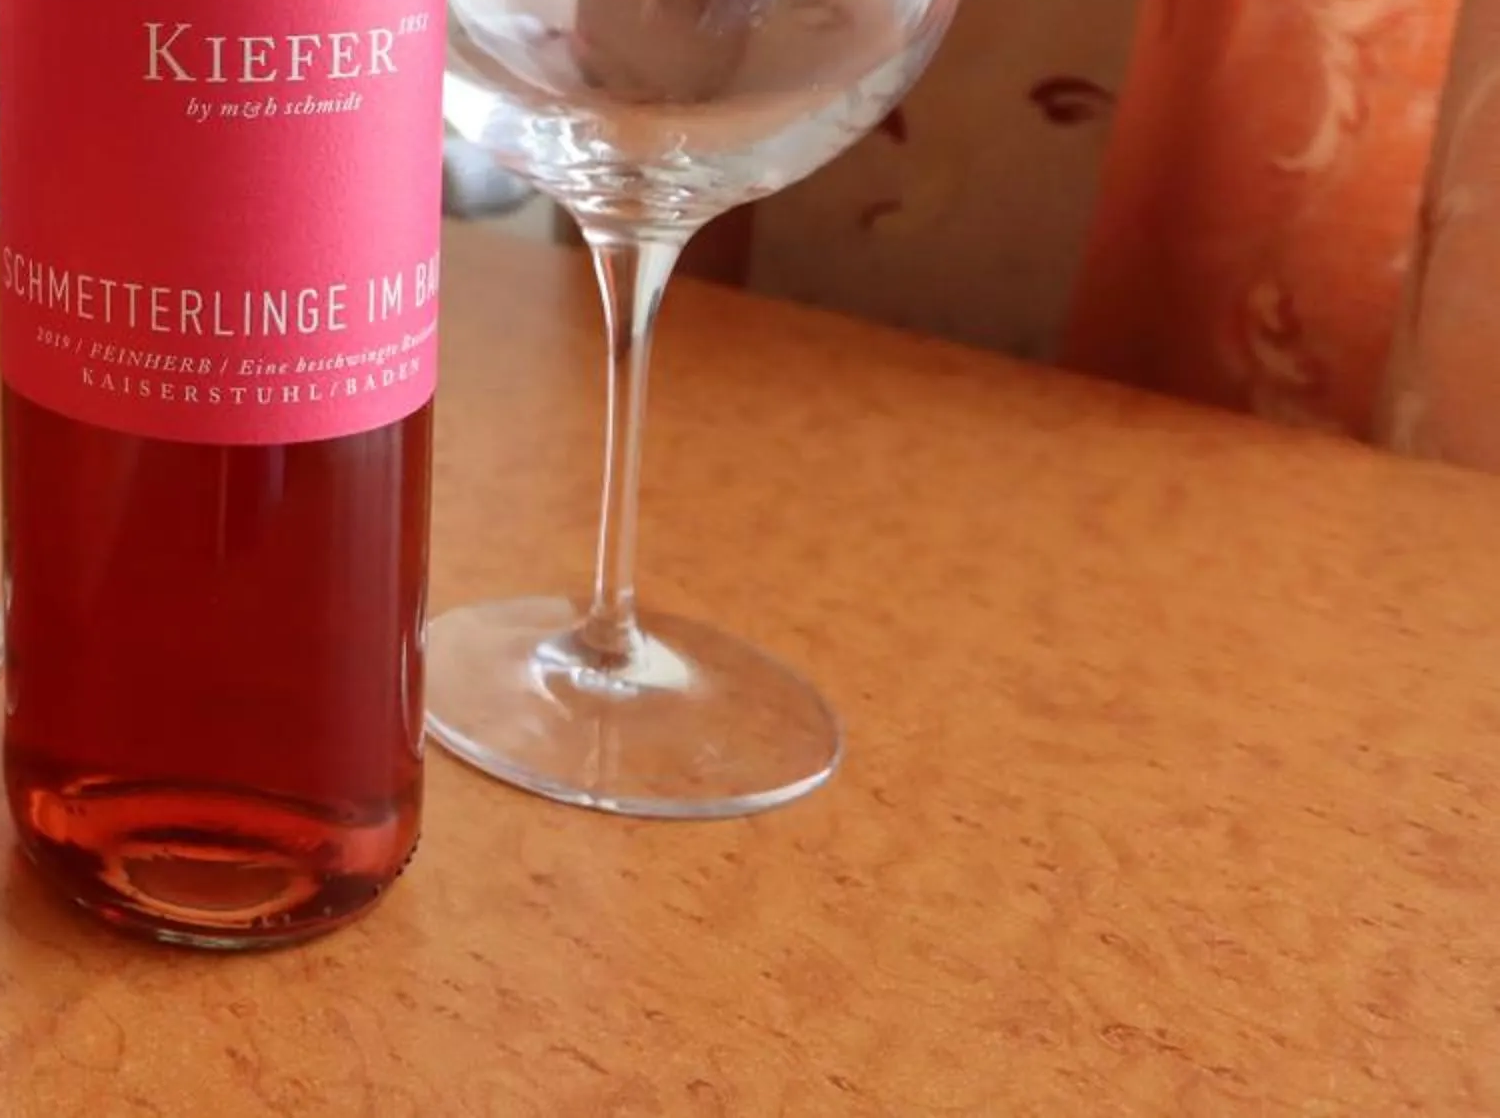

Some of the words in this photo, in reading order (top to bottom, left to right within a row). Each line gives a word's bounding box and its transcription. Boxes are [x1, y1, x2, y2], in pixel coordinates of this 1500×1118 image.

[143, 22, 398, 83] KIEFER
[186, 96, 212, 123] by
[283, 90, 363, 116] schmidt
[2, 245, 348, 337] SCHMETTERLINGE
[367, 271, 404, 323] IM
[35, 325, 72, 348] 2019
[89, 340, 213, 375] FEINHERB
[238, 356, 289, 376] Eine
